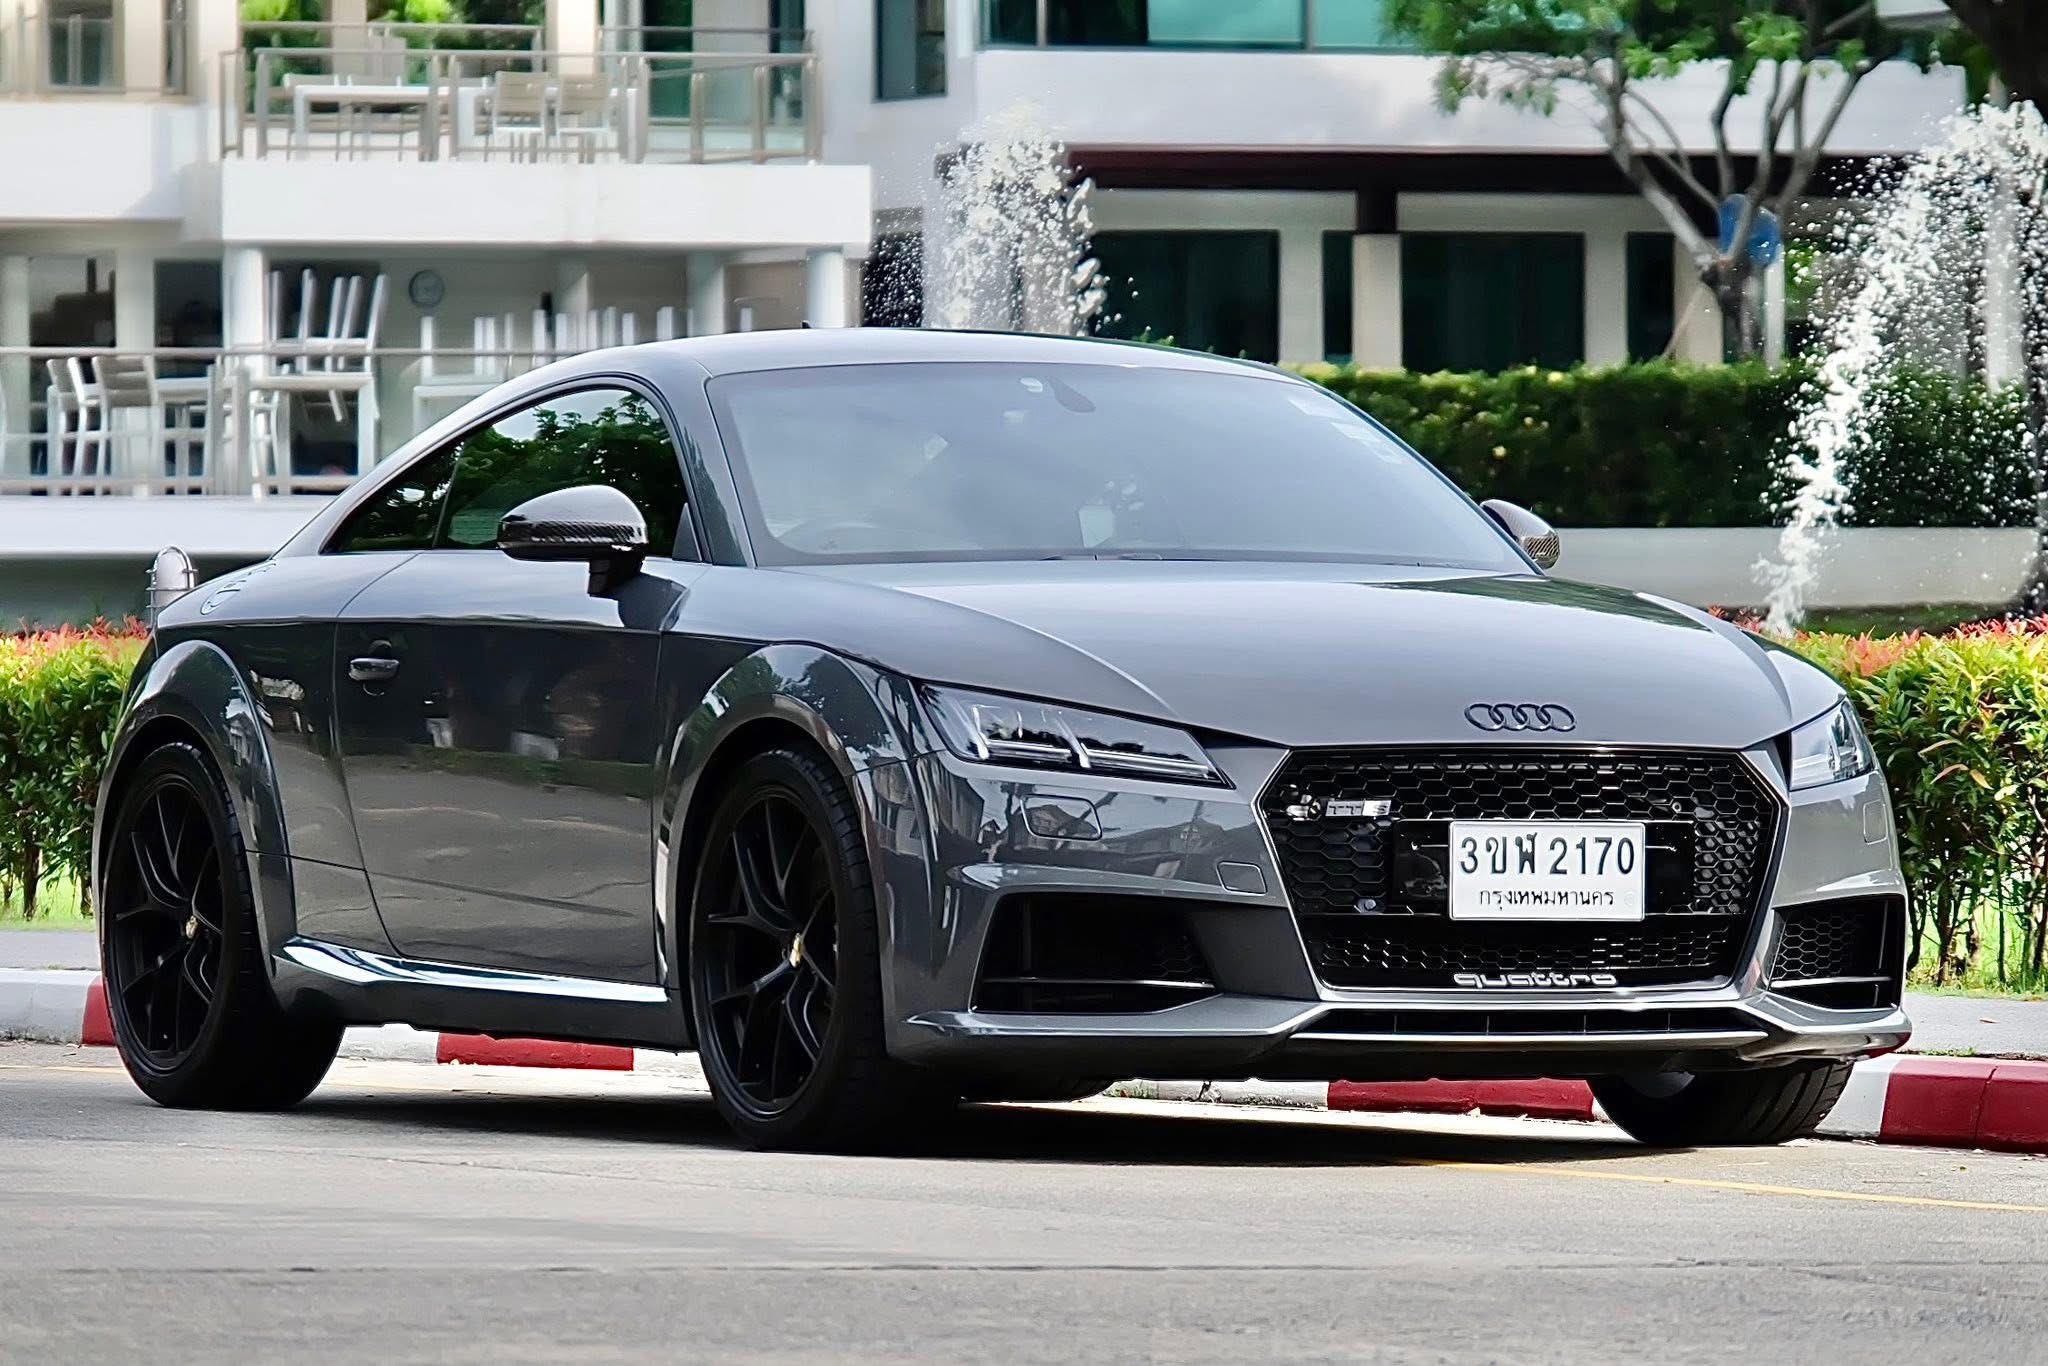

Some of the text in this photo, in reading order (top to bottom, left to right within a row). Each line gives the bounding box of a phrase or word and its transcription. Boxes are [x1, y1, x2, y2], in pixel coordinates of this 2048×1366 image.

[1549, 837, 1635, 875] 2170
[1479, 889, 1614, 910] กรุงเทพมหานคร
[1453, 972, 1617, 988] quattro
